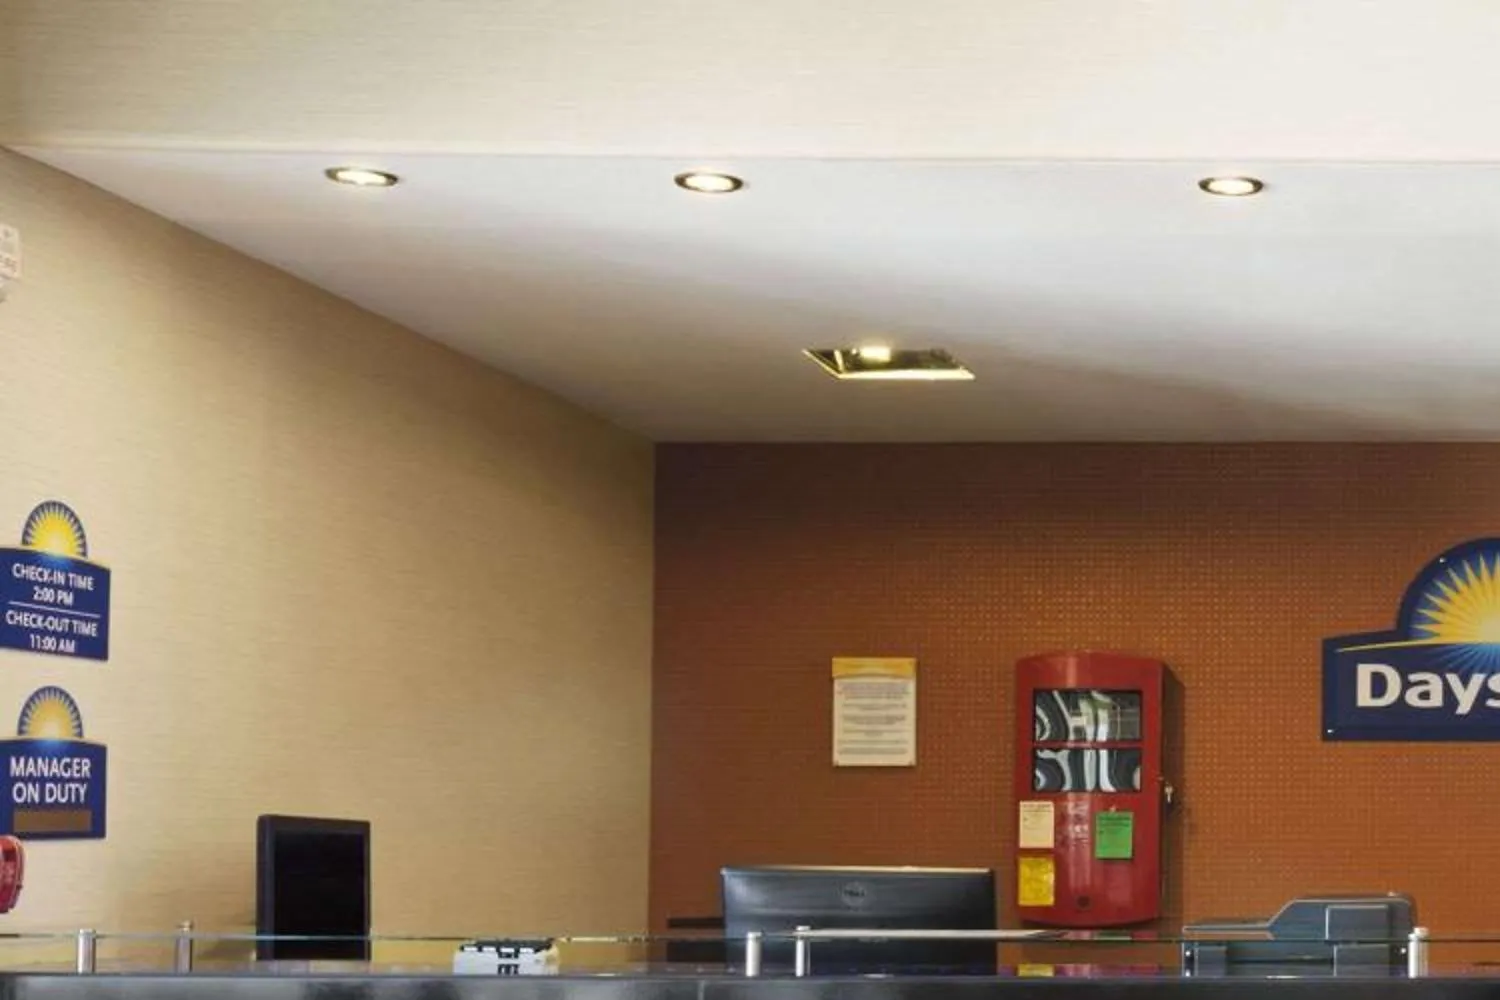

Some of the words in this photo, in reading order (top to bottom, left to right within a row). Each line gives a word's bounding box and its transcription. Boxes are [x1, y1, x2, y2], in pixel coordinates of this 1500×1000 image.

[12, 563, 65, 585] CHECK-IN
[69, 572, 95, 591] TIME
[33, 586, 55, 603] 2:00
[57, 590, 74, 606] PM
[6, 610, 69, 633] CHECK-OUT
[73, 618, 98, 637] TIME
[29, 634, 57, 651] 11:00
[58, 639, 76, 653] AM
[10, 756, 91, 779] MANAGER
[12, 783, 40, 804] ON
[45, 783, 87, 804] DUTY
